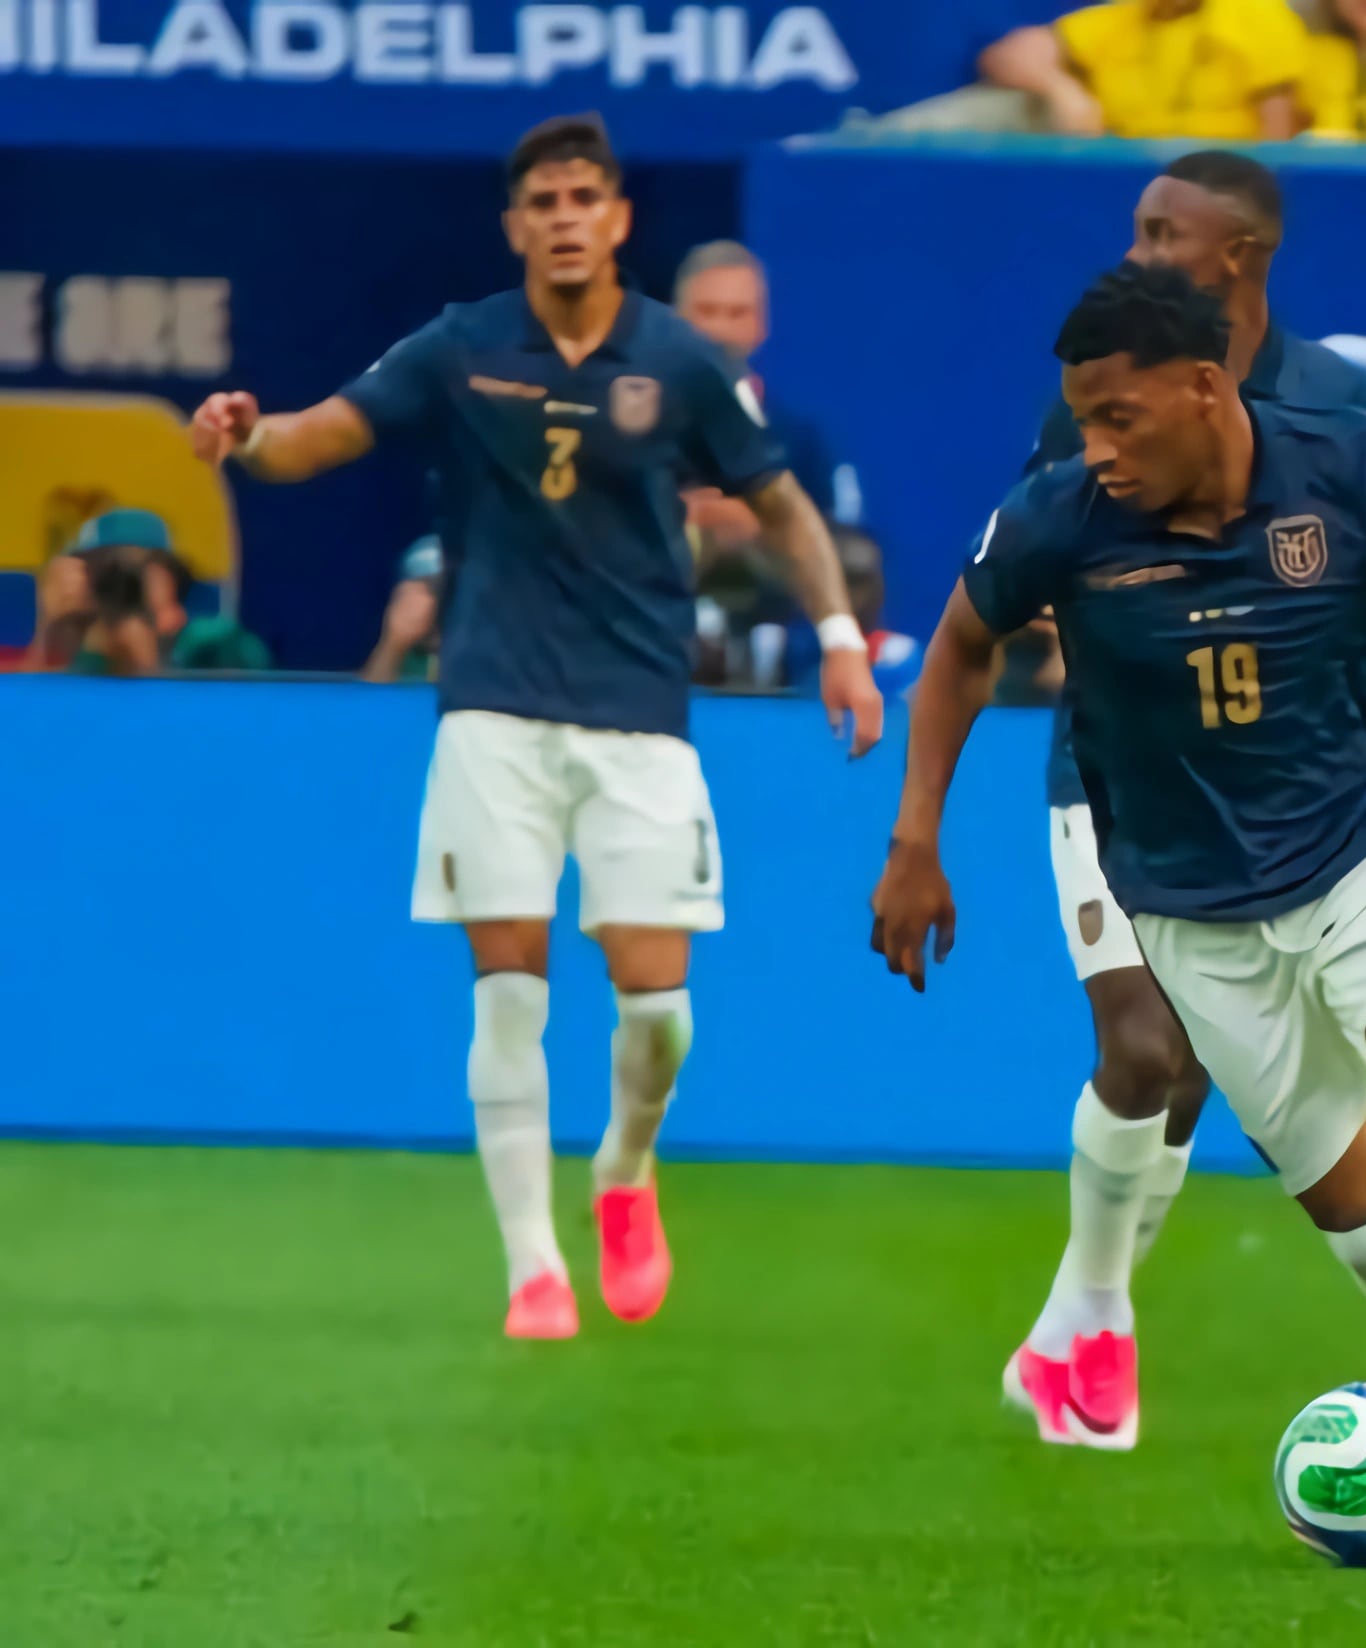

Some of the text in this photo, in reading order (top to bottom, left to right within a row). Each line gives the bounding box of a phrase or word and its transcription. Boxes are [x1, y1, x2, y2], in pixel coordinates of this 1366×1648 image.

[0, 0, 859, 91] ILADELPHIA
[541, 427, 582, 501] 3
[1186, 642, 1264, 729] 19
